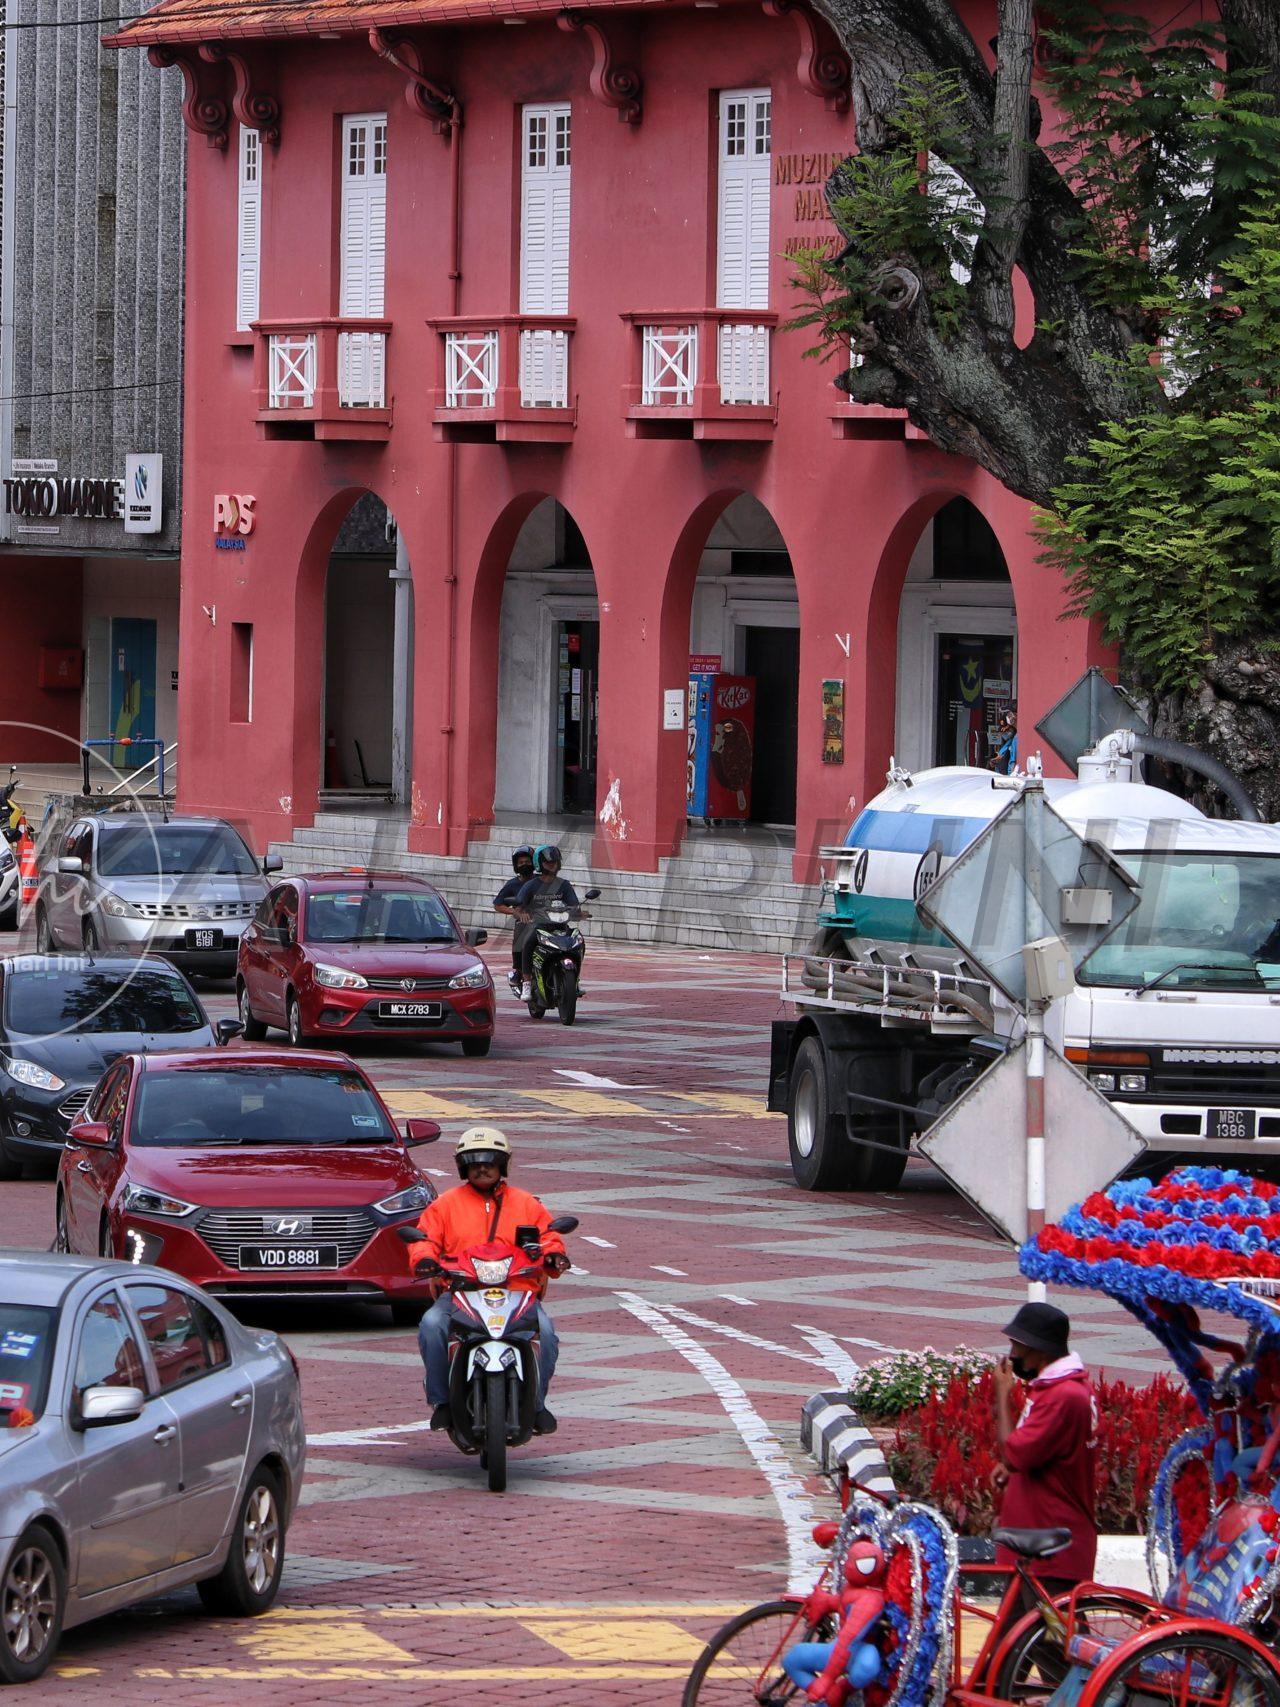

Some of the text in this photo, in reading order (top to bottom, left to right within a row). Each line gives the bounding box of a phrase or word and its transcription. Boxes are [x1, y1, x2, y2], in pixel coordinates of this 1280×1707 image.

[390, 1004, 430, 1015] MCX 2783
[1219, 1110, 1244, 1124] MBC
[1216, 1124, 1246, 1137] 1386
[259, 1250, 320, 1265] VDD 8881
